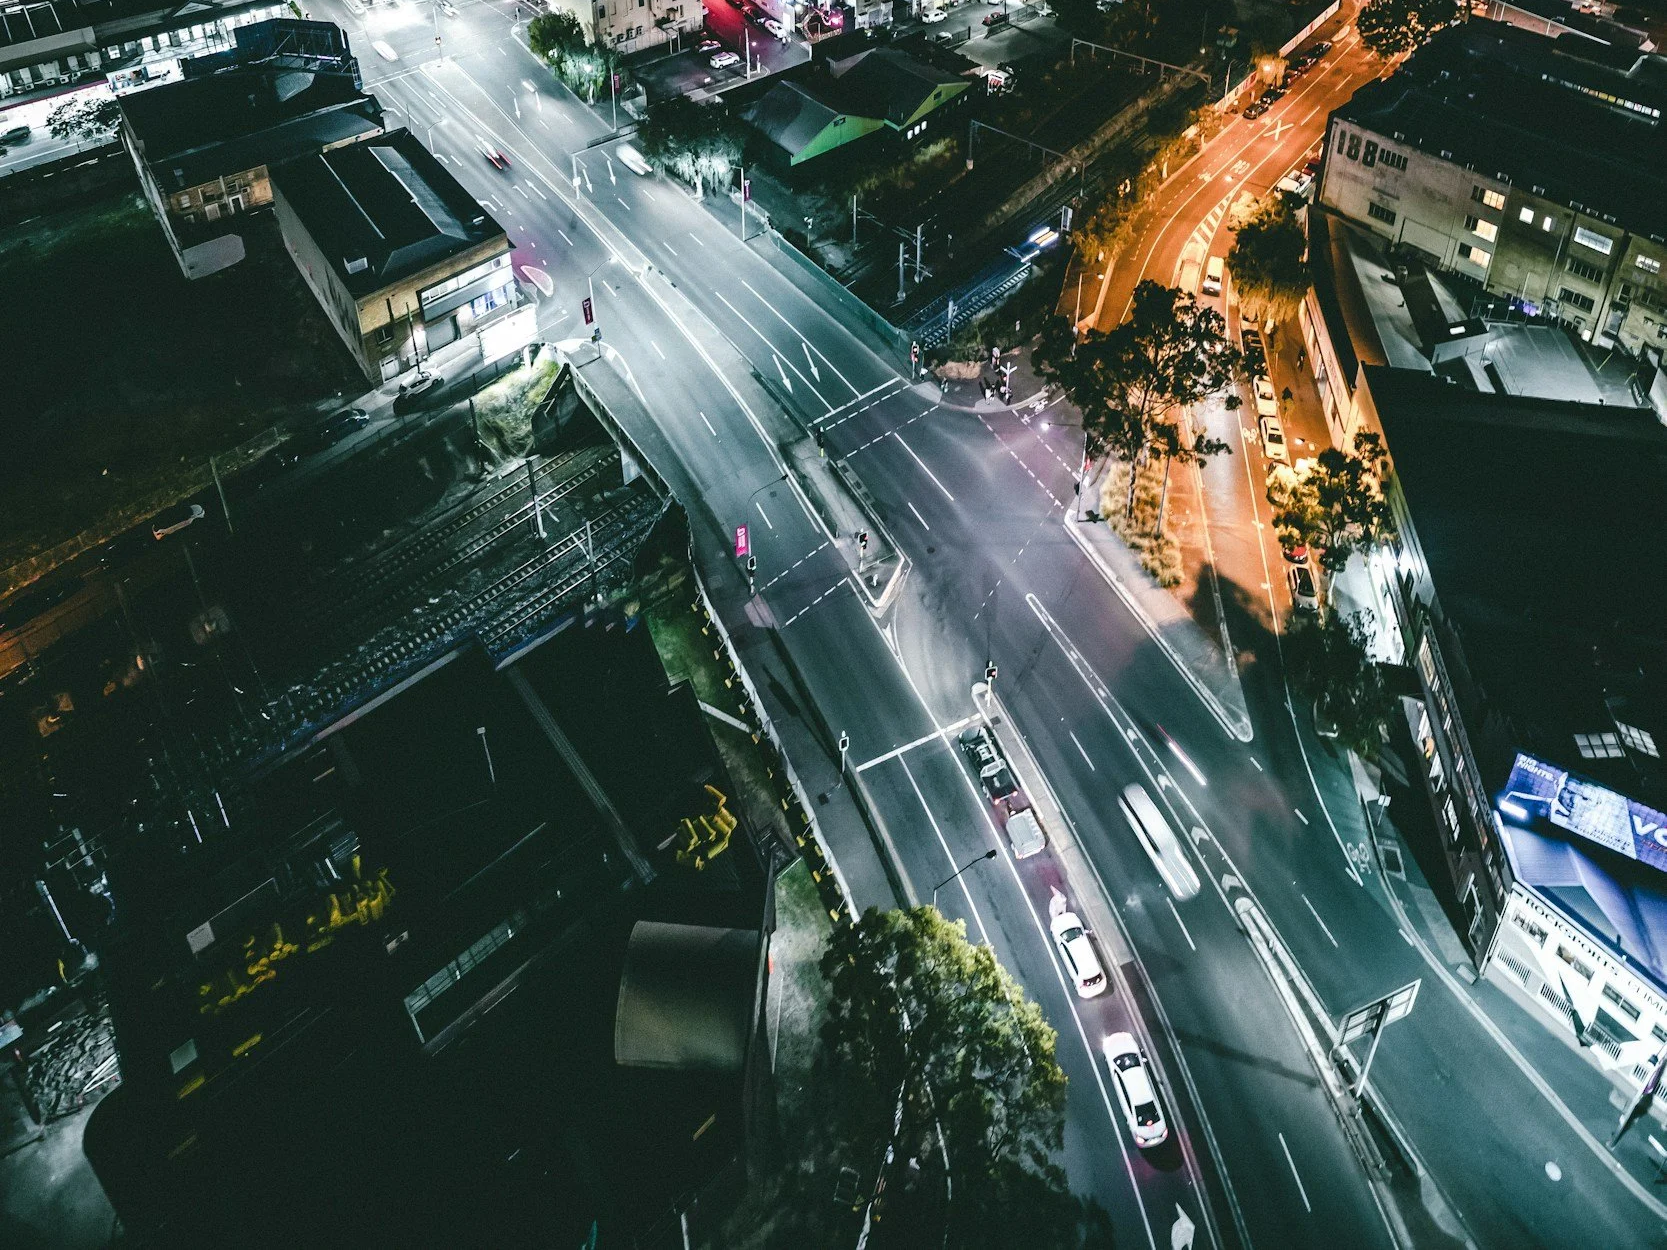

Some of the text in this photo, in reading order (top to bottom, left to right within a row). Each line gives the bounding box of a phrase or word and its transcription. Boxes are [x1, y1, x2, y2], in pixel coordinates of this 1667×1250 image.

[1337, 129, 1379, 168] 188
[1519, 754, 1537, 767] BIG
[1525, 897, 1620, 977] ROCKSPORTS
